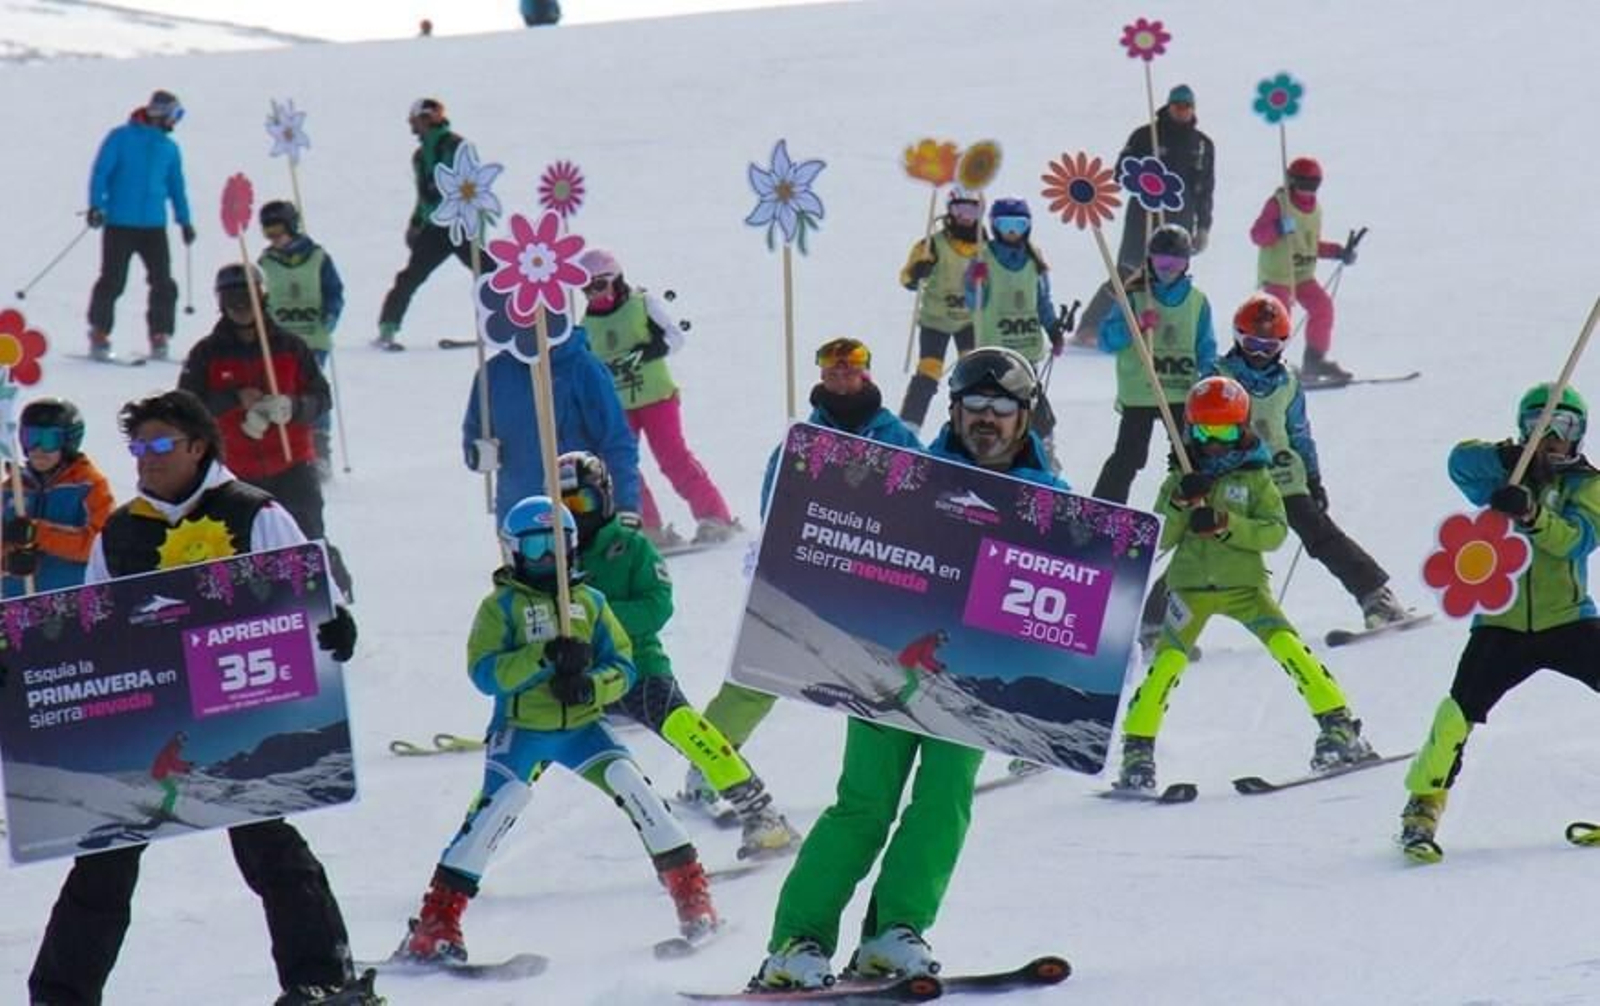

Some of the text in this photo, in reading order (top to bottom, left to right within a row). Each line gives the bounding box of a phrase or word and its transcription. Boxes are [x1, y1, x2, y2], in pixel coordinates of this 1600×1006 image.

[866, 517, 881, 535] la
[795, 545, 928, 593] sierranevada
[801, 522, 961, 581] PRIMAVERA en
[1004, 547, 1100, 585] FORFAIT
[207, 613, 304, 647] APRENDE
[1020, 619, 1074, 647] 3000
[78, 660, 94, 674] la
[27, 669, 177, 708] PRIMAVERA en
